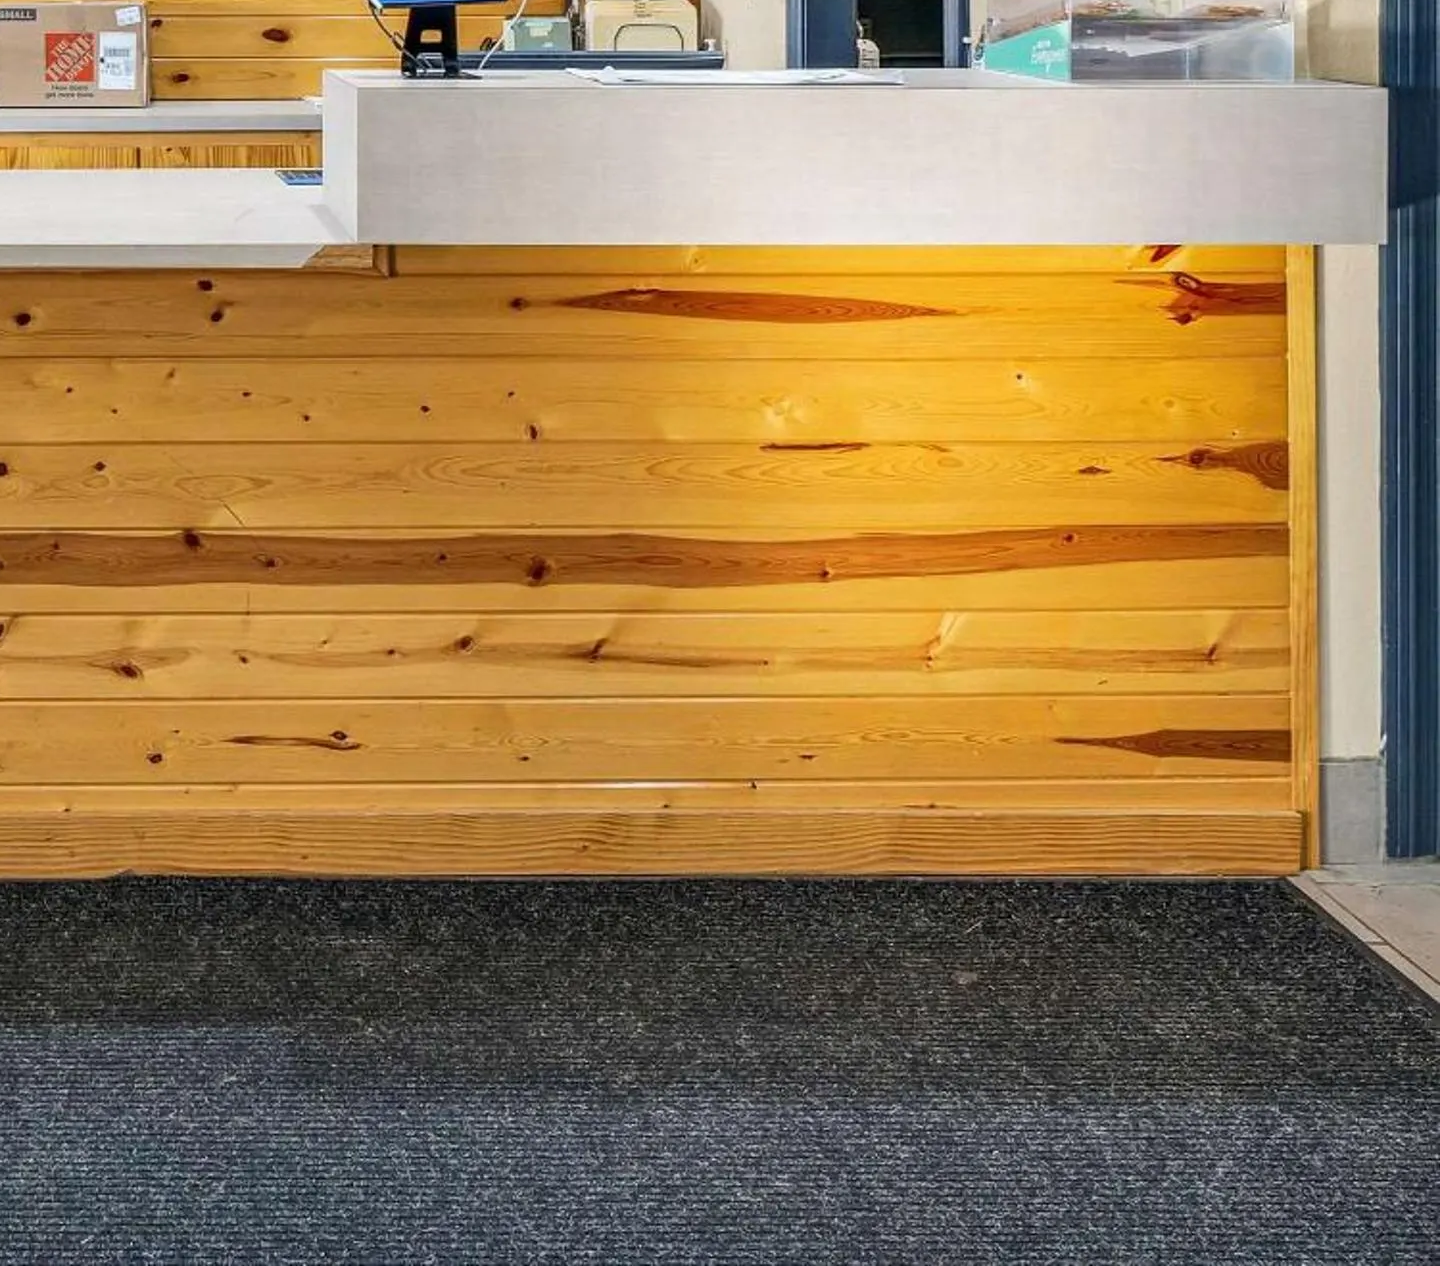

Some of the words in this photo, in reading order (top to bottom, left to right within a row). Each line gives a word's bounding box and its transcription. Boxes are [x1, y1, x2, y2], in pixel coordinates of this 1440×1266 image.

[0, 10, 34, 19] SMALL
[46, 34, 97, 82] HOME
[50, 40, 70, 57] THE
[65, 52, 95, 80] DEPOT
